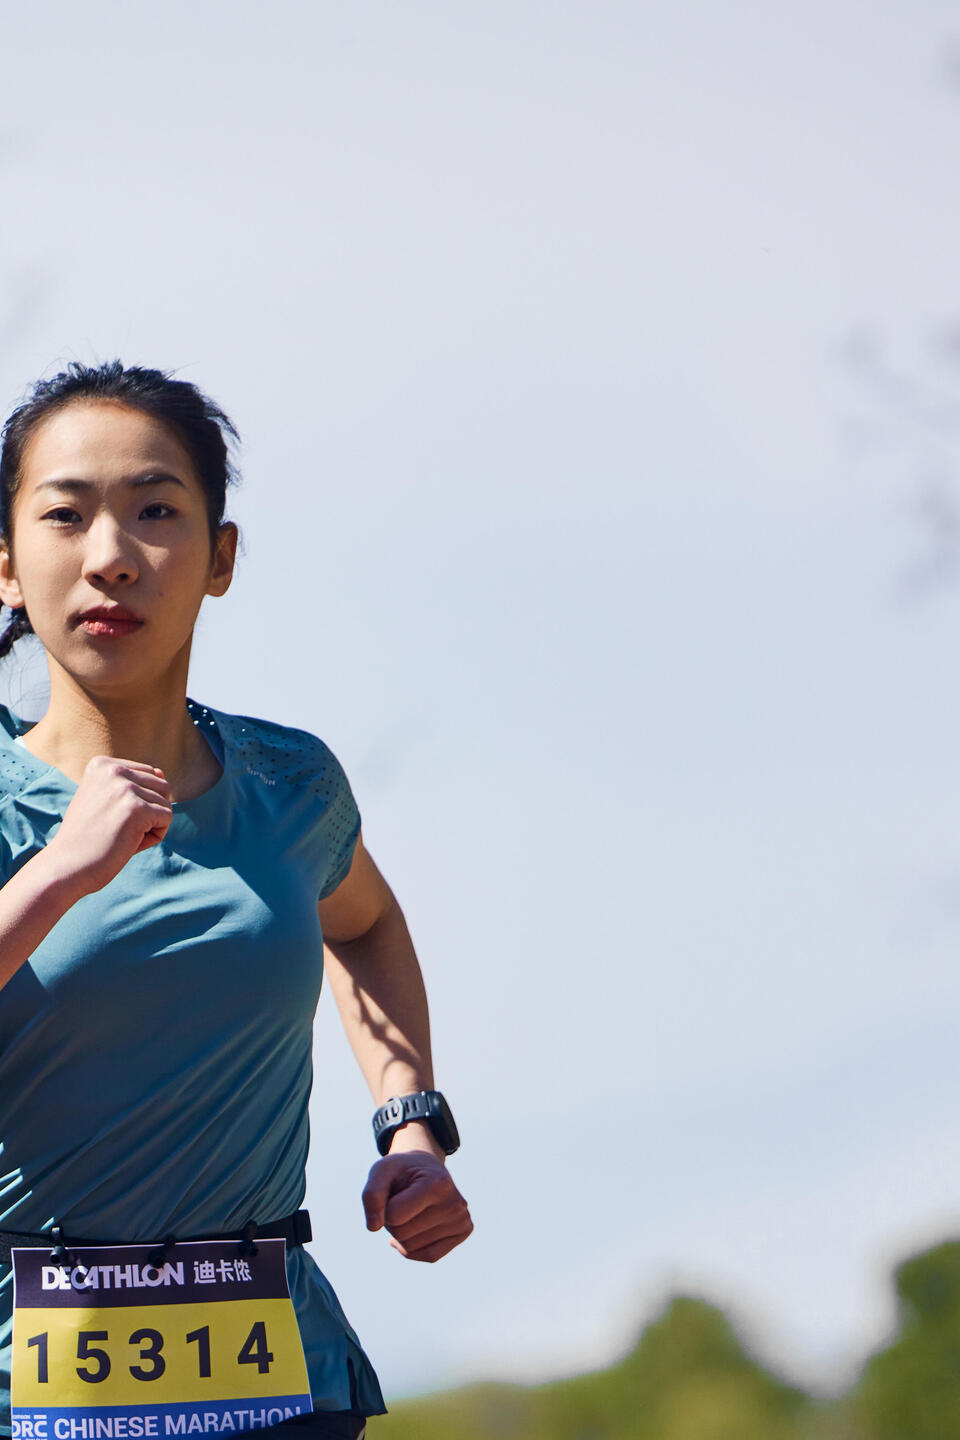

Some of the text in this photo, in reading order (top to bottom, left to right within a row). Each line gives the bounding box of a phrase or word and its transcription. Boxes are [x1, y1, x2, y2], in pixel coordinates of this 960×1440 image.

[41, 1261, 184, 1290] DECATHLON
[193, 1259, 252, 1284] 迪卡侬
[27, 1321, 274, 1384] 15314
[54, 1416, 158, 1440] CHINESE
